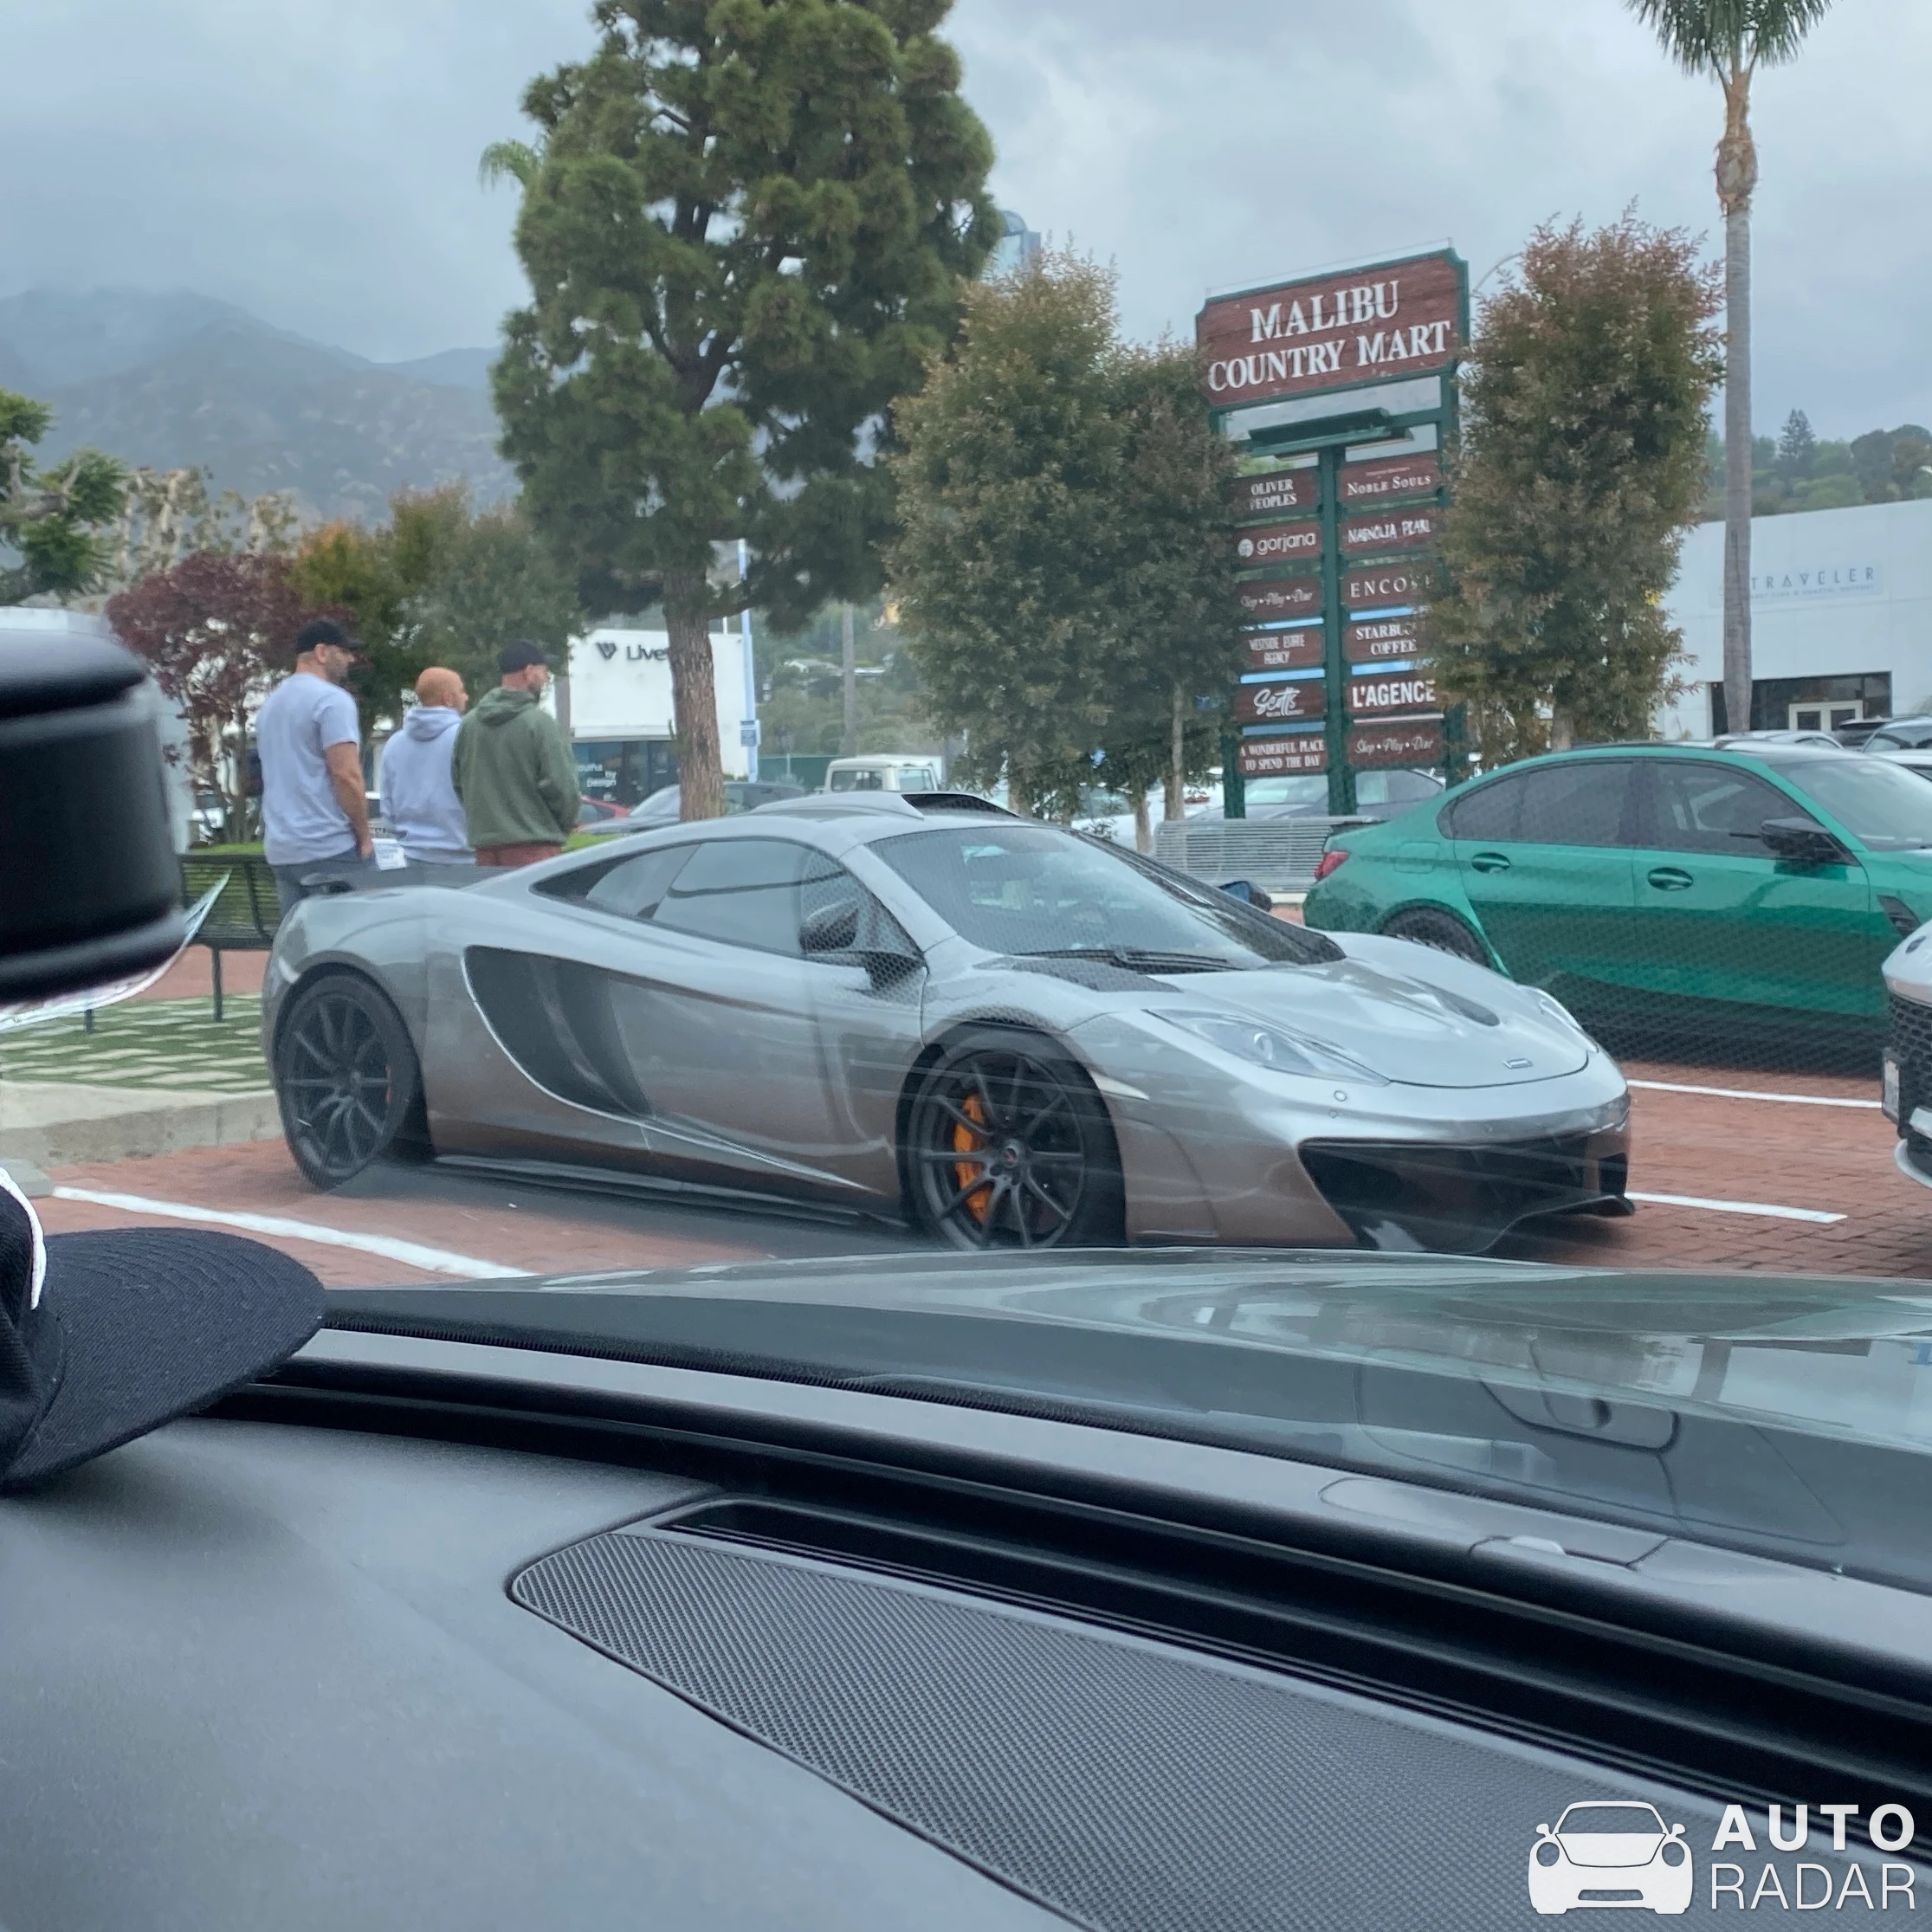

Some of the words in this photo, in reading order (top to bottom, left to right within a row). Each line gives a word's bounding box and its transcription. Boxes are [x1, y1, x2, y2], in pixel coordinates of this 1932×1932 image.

[1250, 280, 1399, 343] MALIBU
[1208, 339, 1347, 391] COUNTRY
[1357, 320, 1451, 366] MART
[1250, 479, 1293, 495] OLIVER
[1249, 493, 1297, 511] PEOPLES
[1257, 533, 1315, 555] gorjana
[1350, 575, 1431, 598] ENCO
[1751, 566, 1874, 590] TRAVELER
[627, 644, 668, 661] Live
[1370, 639, 1418, 655] COFFEE
[1352, 679, 1436, 708] L'AGENCE
[1248, 742, 1297, 756] WONDERFUL
[1299, 739, 1325, 753] PLACE
[1244, 759, 1257, 771] TO
[1258, 757, 1283, 770] SPEND
[1285, 756, 1302, 768] THE
[1304, 754, 1321, 767] DAY
